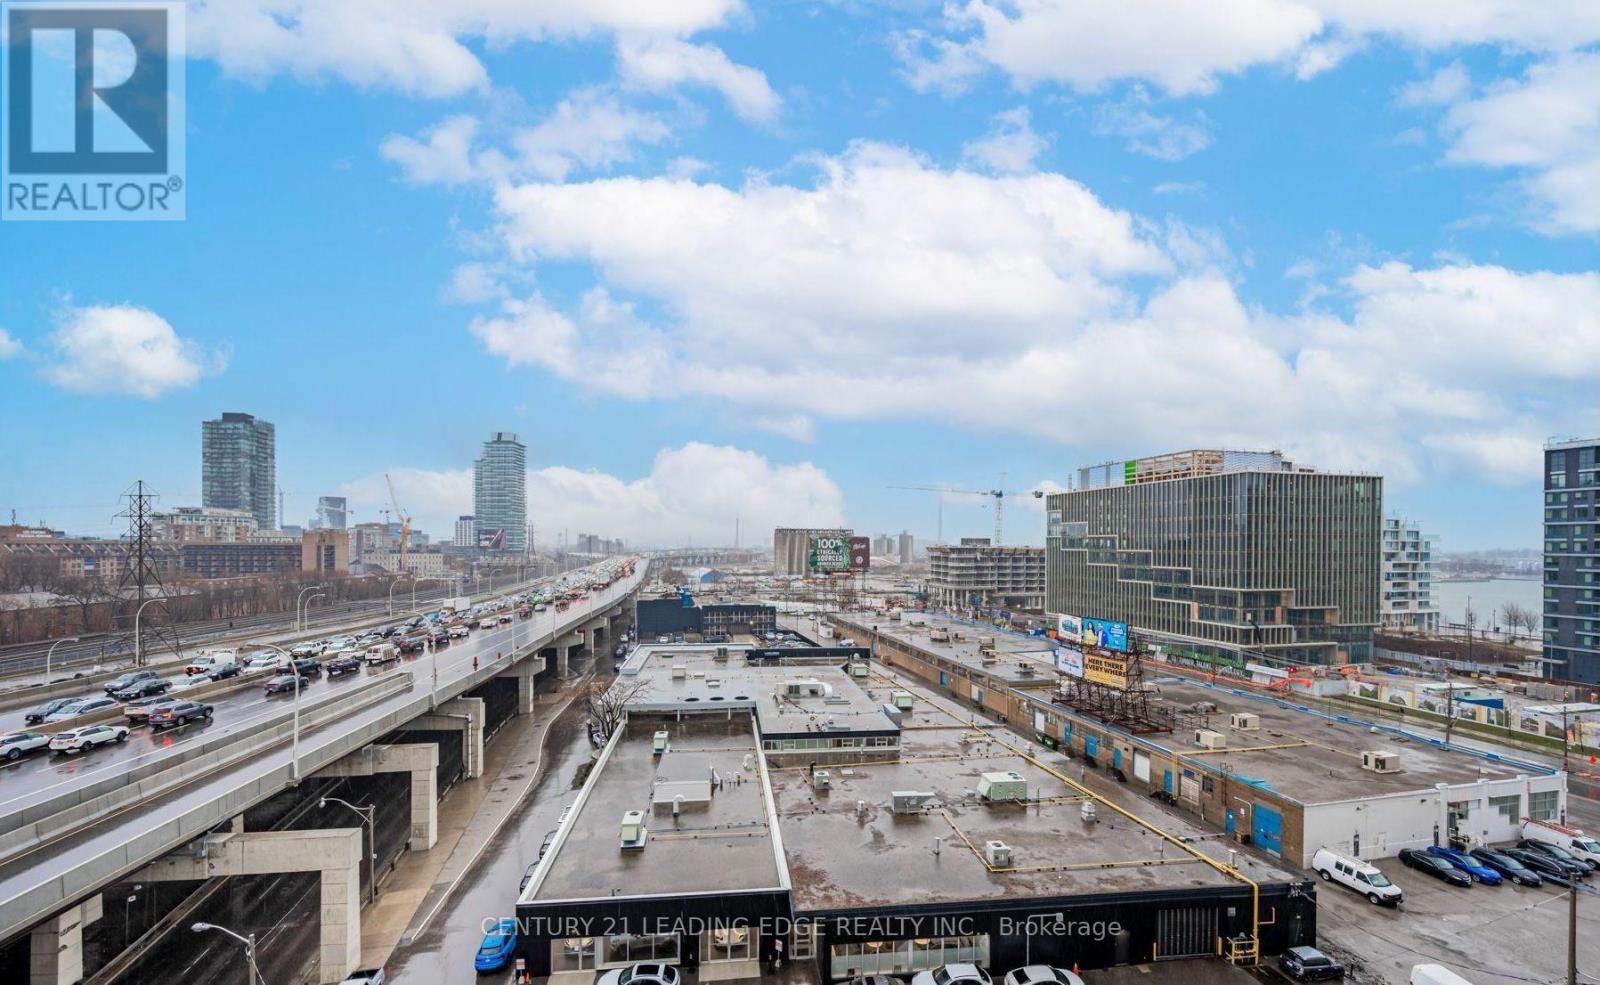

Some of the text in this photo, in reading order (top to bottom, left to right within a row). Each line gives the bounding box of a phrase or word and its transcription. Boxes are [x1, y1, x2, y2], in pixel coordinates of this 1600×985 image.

[817, 538, 843, 549] 100%
[816, 555, 843, 563] SOURCED
[1088, 657, 1103, 666] HERE
[1104, 661, 1124, 670] THERE
